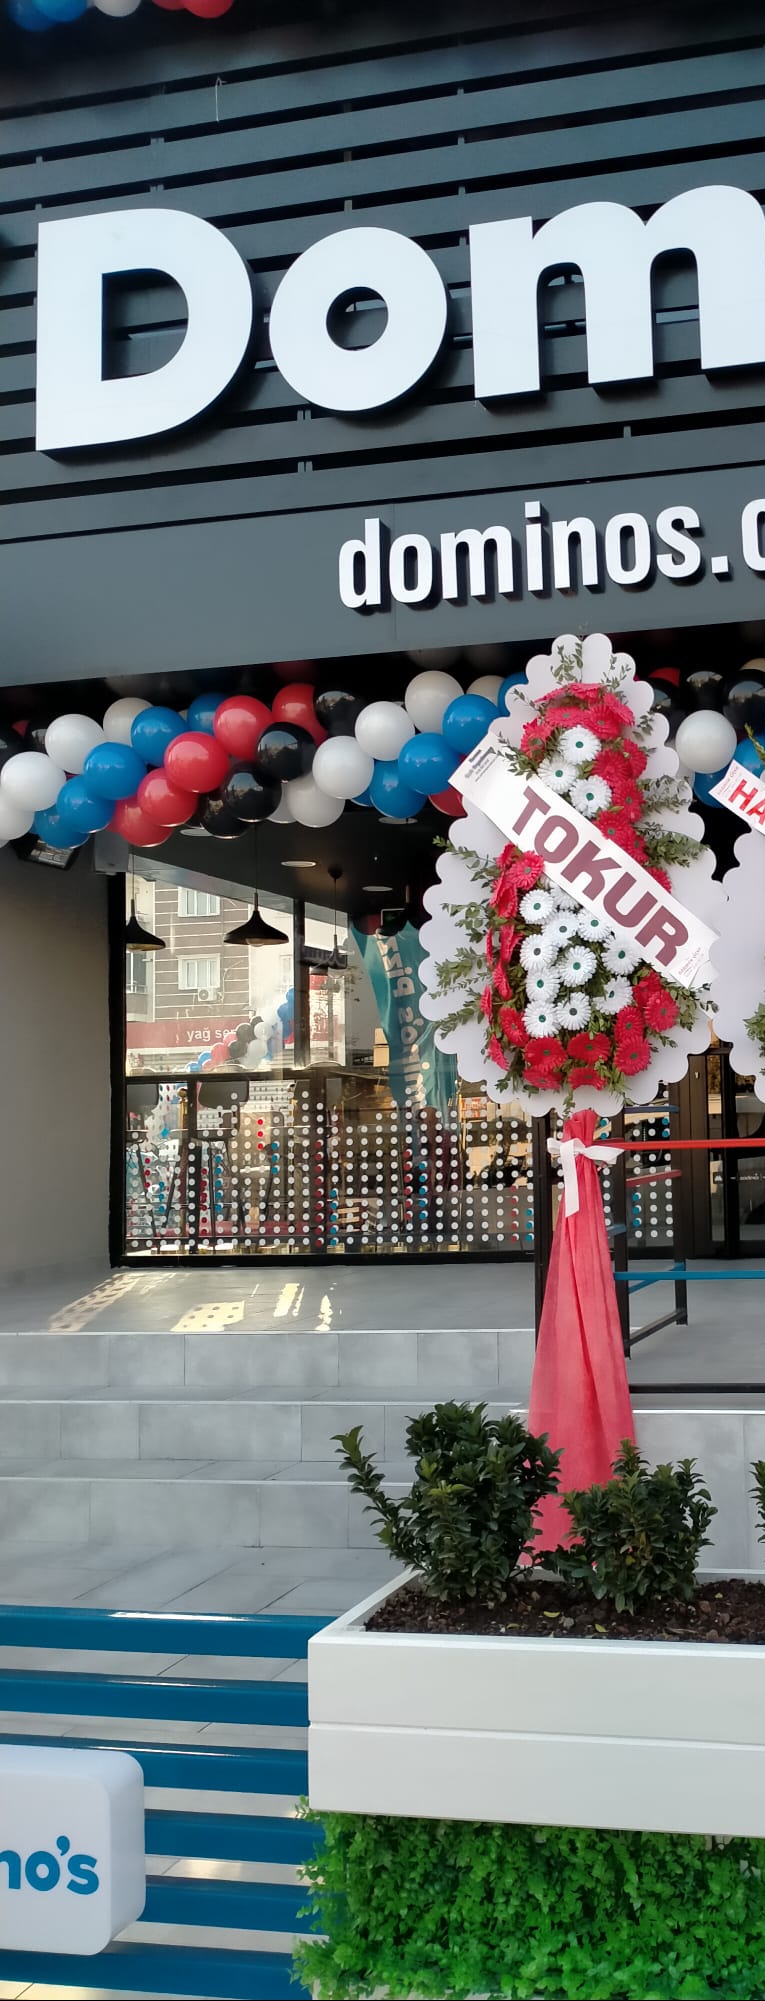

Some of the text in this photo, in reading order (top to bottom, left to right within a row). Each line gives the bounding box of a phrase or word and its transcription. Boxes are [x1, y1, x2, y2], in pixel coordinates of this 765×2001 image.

[36, 185, 765, 452] Dom
[512, 786, 689, 967] TOKUR
[186, 1027, 211, 1042] yağ
